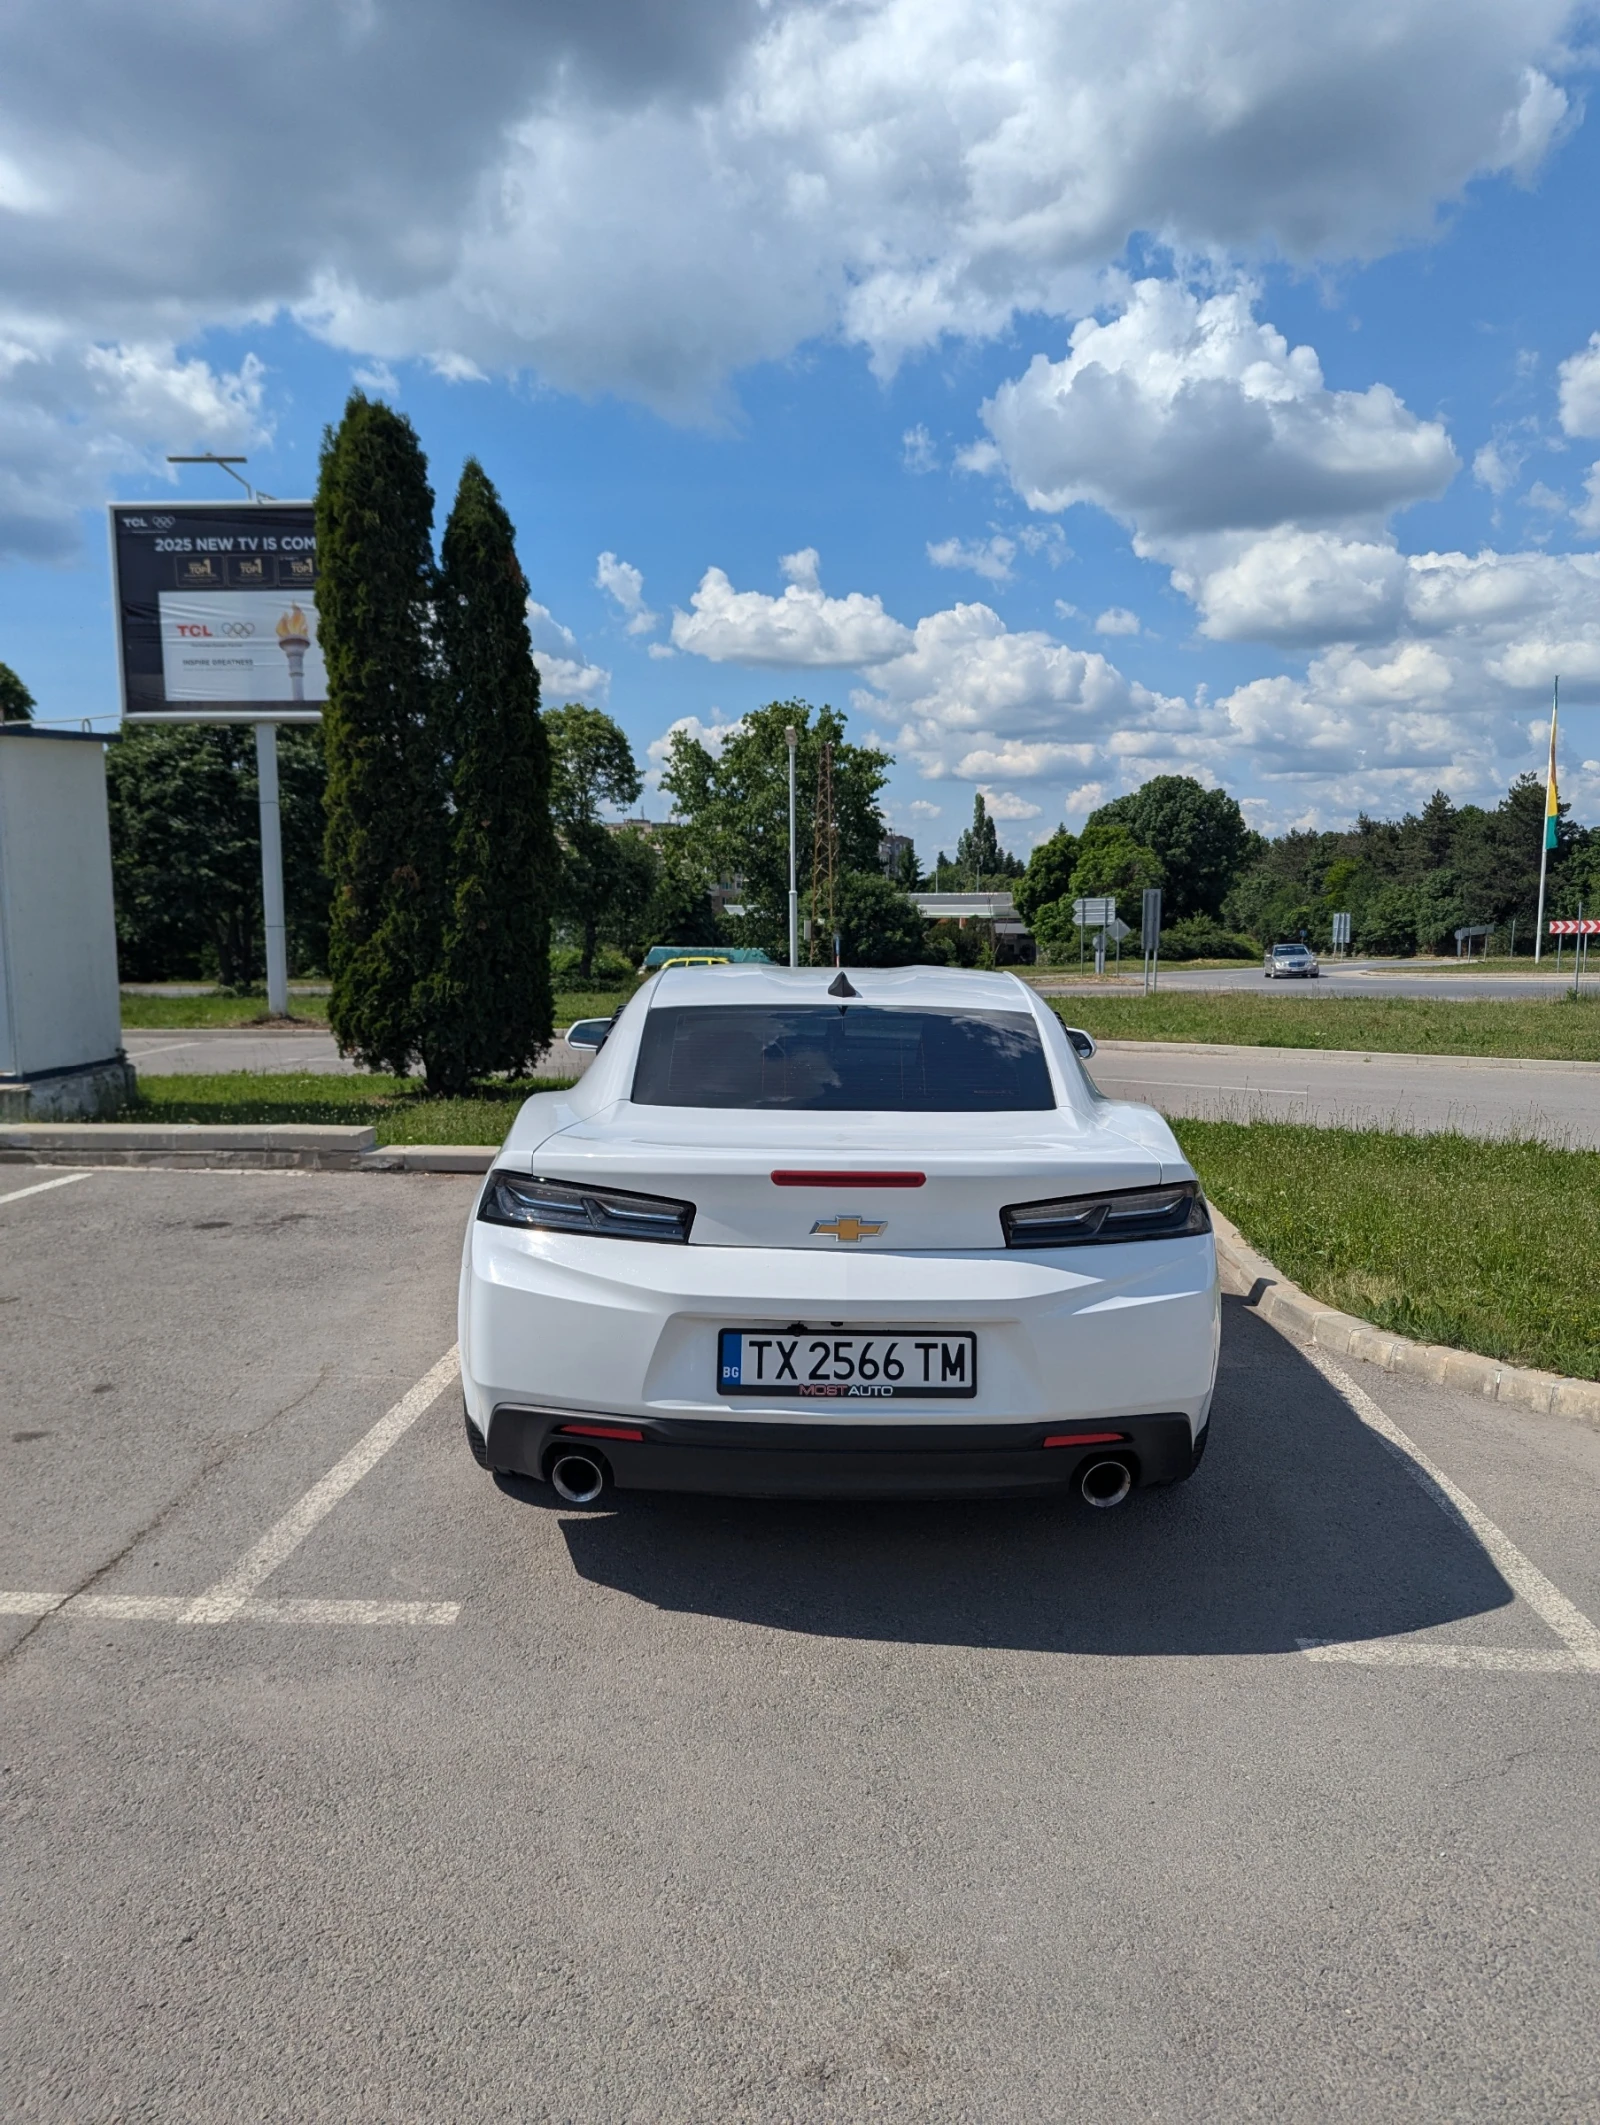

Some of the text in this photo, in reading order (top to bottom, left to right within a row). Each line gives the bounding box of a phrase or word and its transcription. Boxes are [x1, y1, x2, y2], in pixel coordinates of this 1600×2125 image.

[123, 517, 148, 528] TCL
[155, 538, 192, 551] 2025
[196, 537, 233, 551] NEW
[238, 537, 258, 550] TV
[263, 537, 277, 550] IS
[176, 624, 213, 637] TCL
[808, 1342, 904, 1380] 2566
[915, 1343, 965, 1382] TM
[723, 1366, 739, 1378] BG
